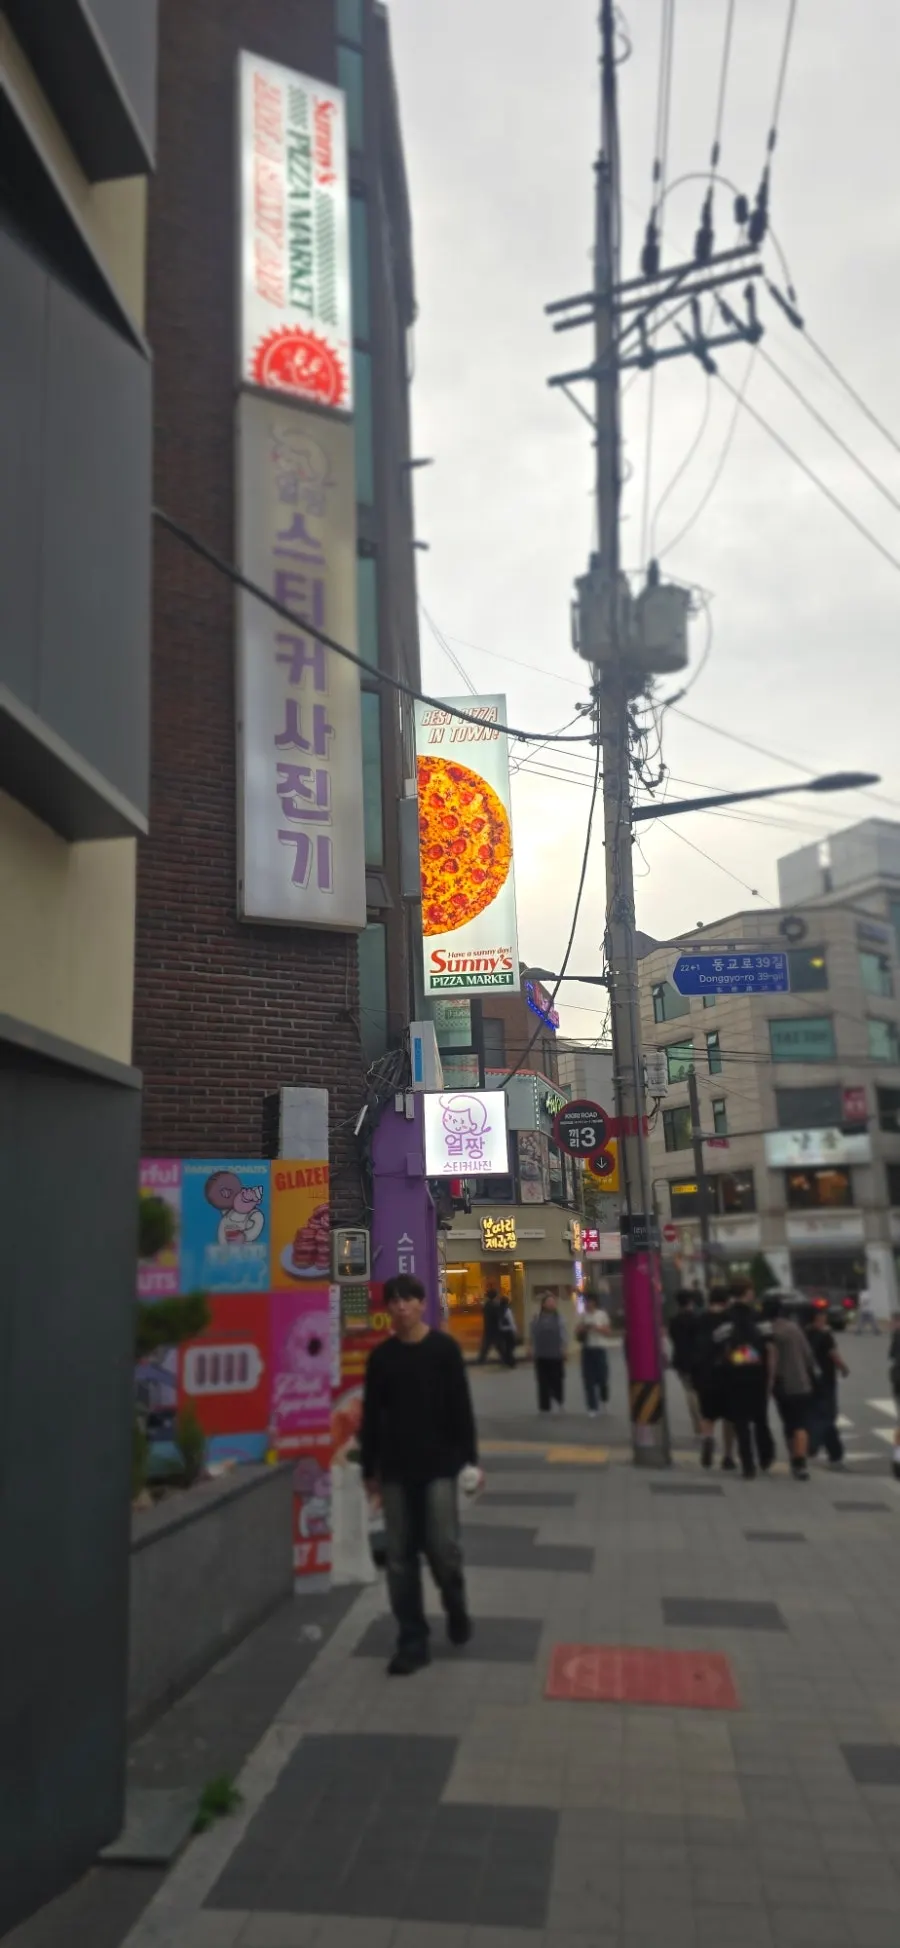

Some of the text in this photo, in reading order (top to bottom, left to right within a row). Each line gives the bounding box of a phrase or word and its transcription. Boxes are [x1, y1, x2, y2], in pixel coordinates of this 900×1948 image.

[312, 95, 336, 186] Sunny's
[286, 127, 315, 319] PIZZA MARKET
[271, 512, 335, 894] 스티커사진기
[428, 726, 500, 743] IN TOWN!
[448, 951, 465, 959] Have
[473, 949, 497, 957] sunny
[497, 946, 513, 954] day!
[430, 950, 513, 975] Sunny's
[680, 964, 690, 972] 22
[712, 956, 783, 972] 동교로39길
[432, 974, 511, 987] PIZZA MARKET
[699, 971, 784, 984] Donggyo-ro 39-gil
[580, 1111, 598, 1119] ROAD
[568, 1126, 596, 1148] 끼리 3
[445, 1134, 485, 1159] 얼짱
[443, 1160, 492, 1172] 스티커사진
[482, 1217, 516, 1238] 보따리
[485, 1232, 517, 1249] 제과점
